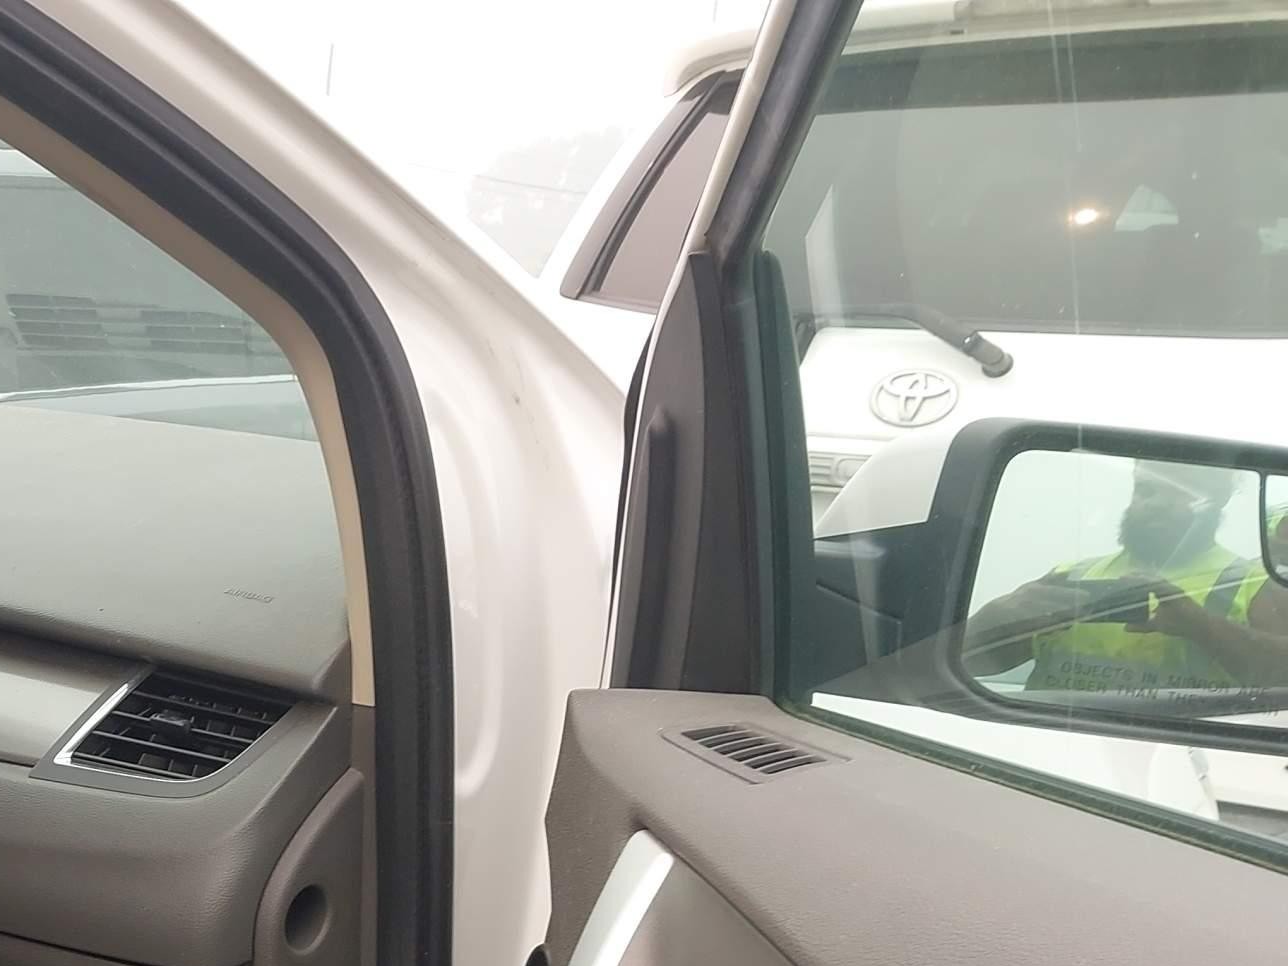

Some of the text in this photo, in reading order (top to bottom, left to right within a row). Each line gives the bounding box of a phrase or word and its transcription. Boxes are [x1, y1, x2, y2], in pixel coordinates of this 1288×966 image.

[1061, 661, 1133, 681] OBJECTS
[1141, 671, 1158, 684] IN
[1167, 674, 1232, 694] MIRROR
